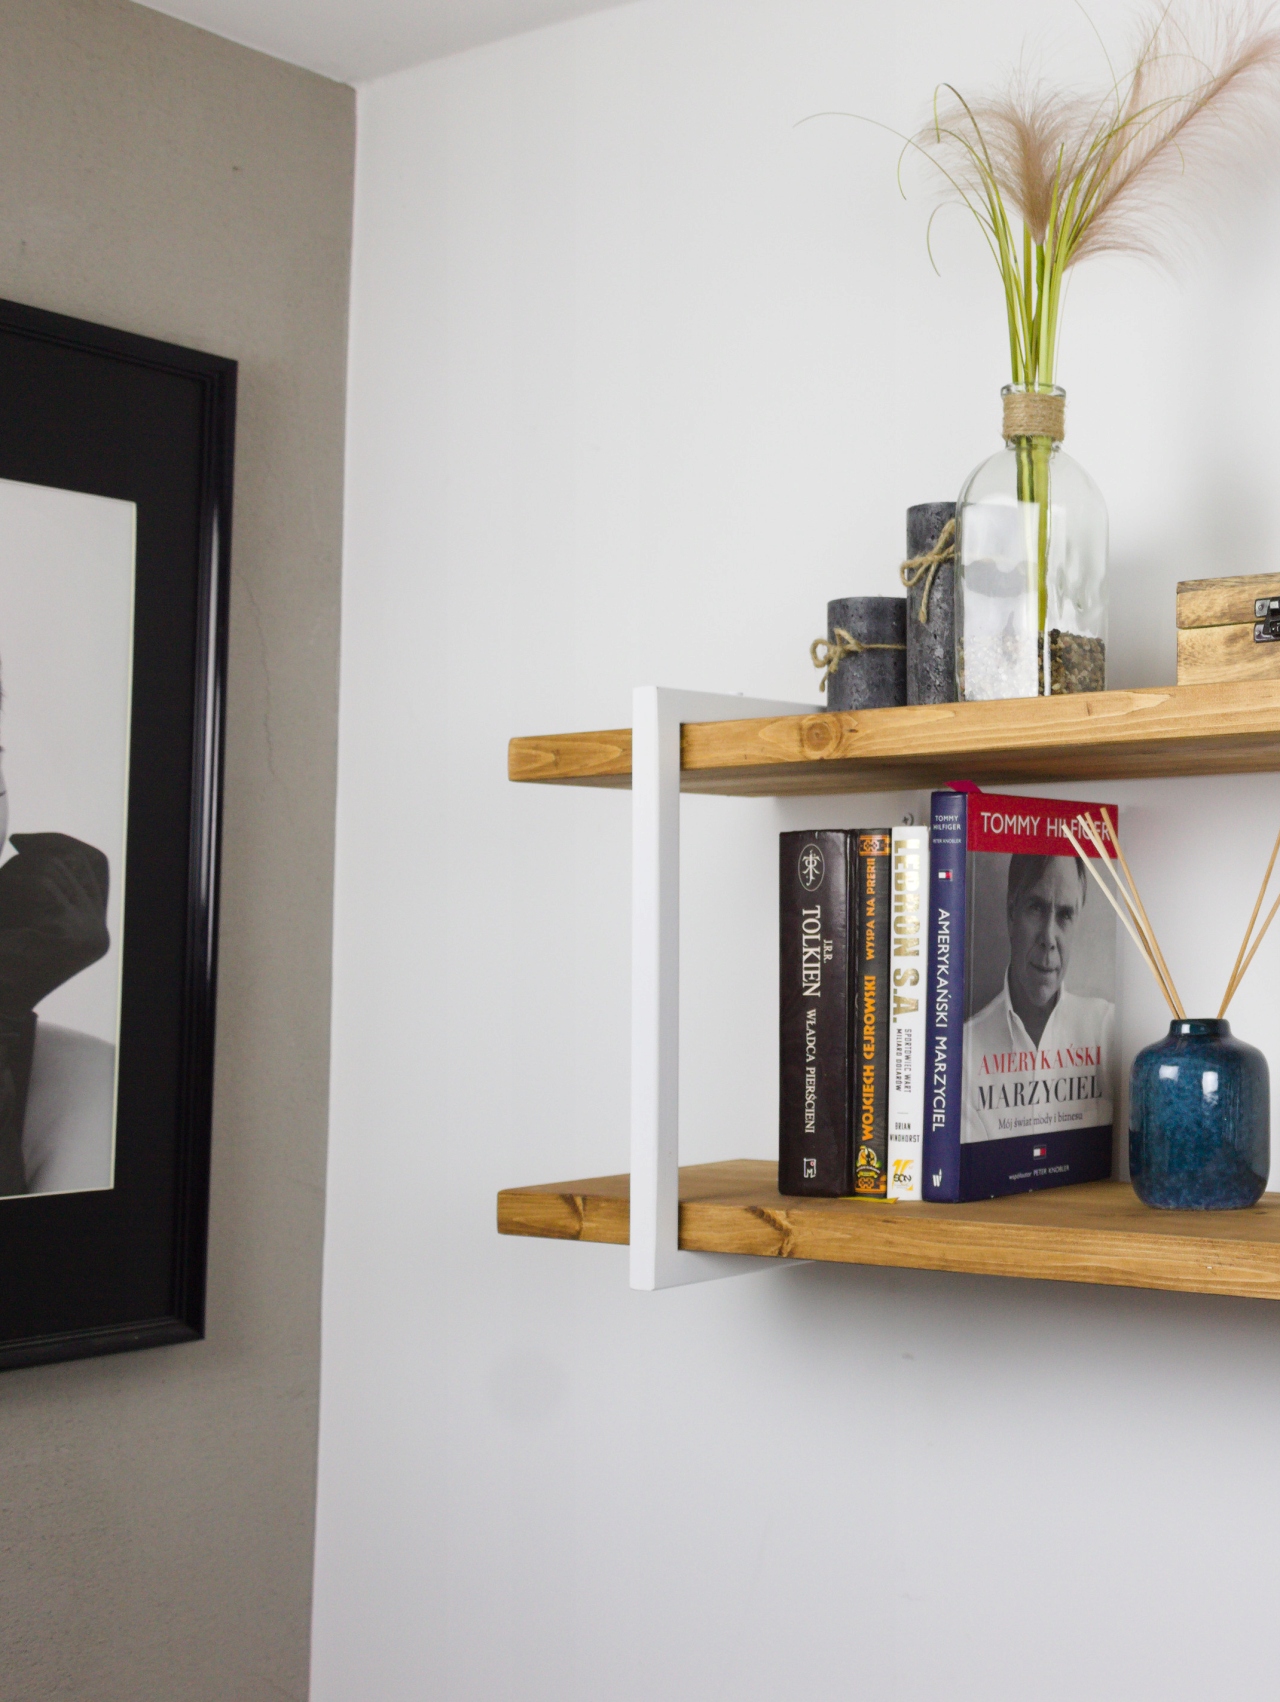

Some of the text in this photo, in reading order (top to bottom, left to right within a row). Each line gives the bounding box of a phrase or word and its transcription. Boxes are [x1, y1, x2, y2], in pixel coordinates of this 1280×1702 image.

[932, 823, 961, 831] HILFIGER
[980, 812, 1041, 836] TOMMY
[865, 857, 876, 961] WYSPA NA PRERII
[802, 905, 821, 998] TOLKIEN
[823, 939, 833, 964] J.R.R.
[932, 908, 952, 1132] AMERYKAŃSKI MARZYCIEL
[804, 1009, 818, 1134] WŁADCA PIERŚCIENI
[861, 975, 877, 1141] WOJCIECH CEJROWSKI
[904, 1028, 912, 1093] SPORTOWIEC WART
[978, 1043, 1102, 1076] AMERYKAŃSKI
[976, 1075, 1103, 1112] MARZYCIEL
[895, 1122, 911, 1130] BRIAN
[998, 1117, 1013, 1130] Mój
[1013, 1116, 1032, 1128] świat
[1033, 1112, 1052, 1125] mody
[1058, 1111, 1083, 1122] biznesu
[889, 1134, 920, 1143] WINDHORST
